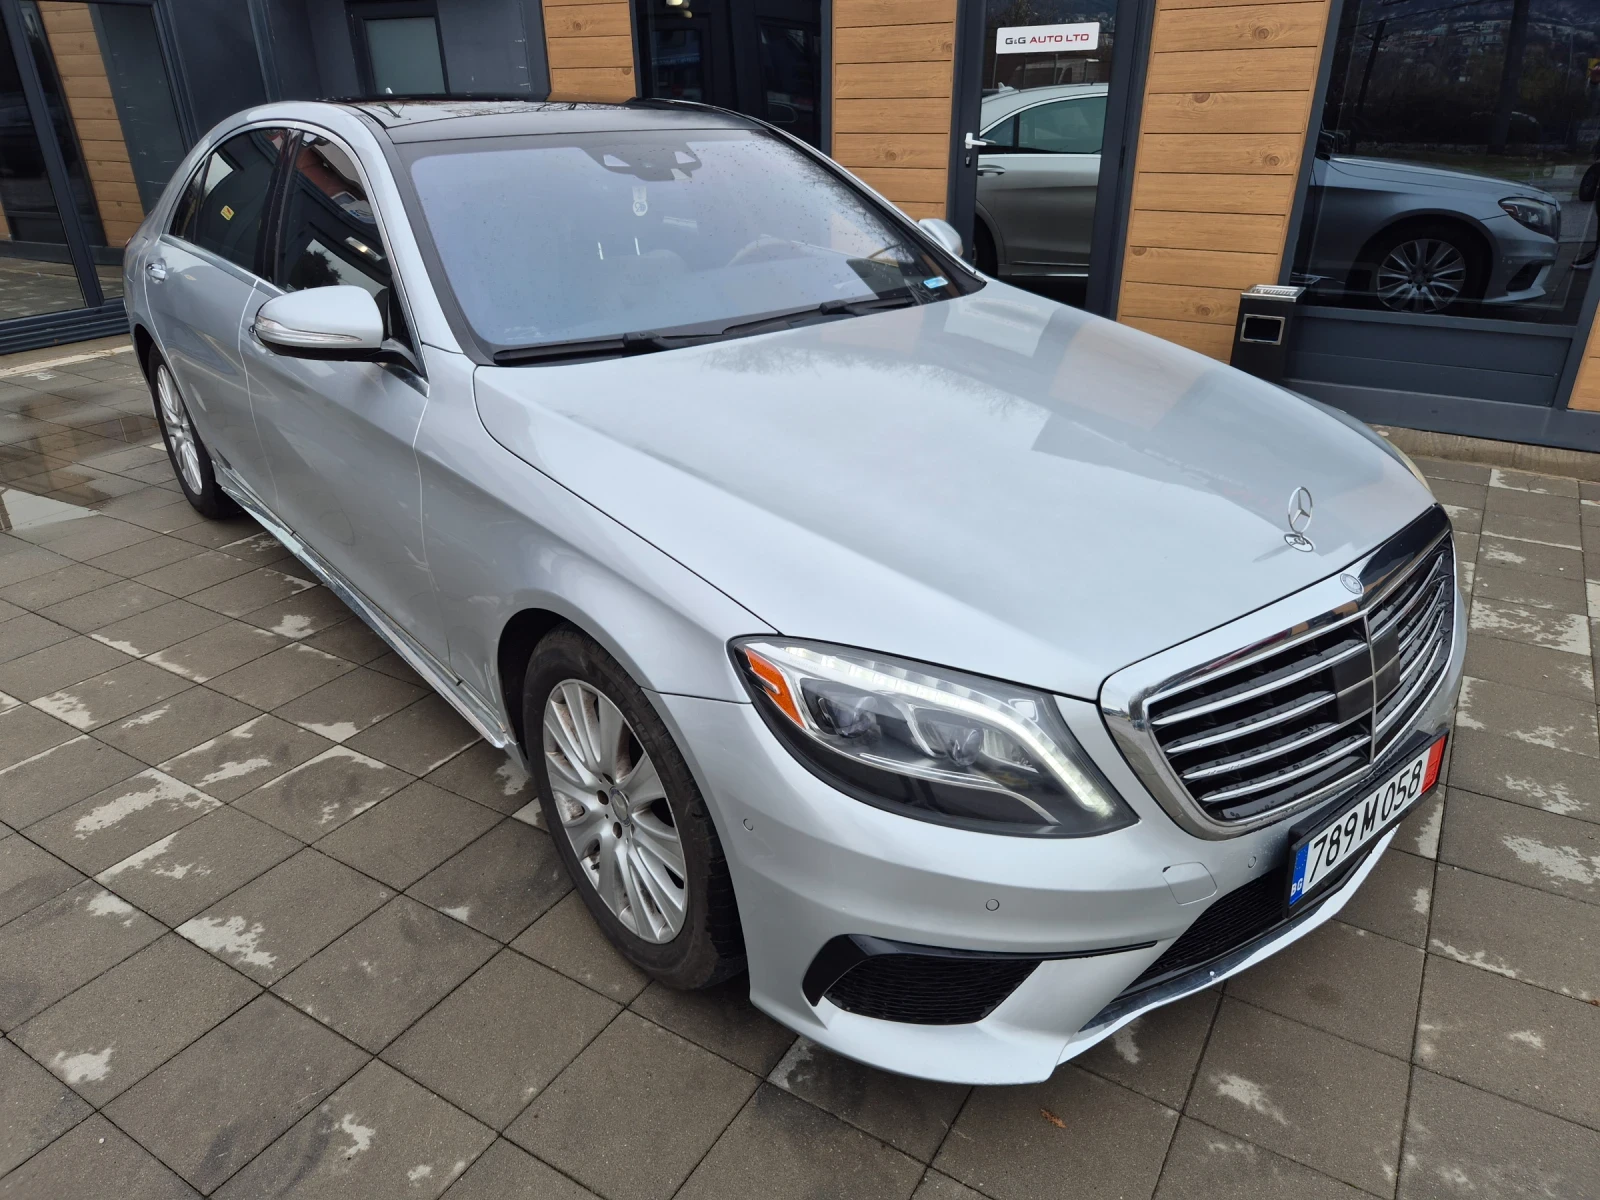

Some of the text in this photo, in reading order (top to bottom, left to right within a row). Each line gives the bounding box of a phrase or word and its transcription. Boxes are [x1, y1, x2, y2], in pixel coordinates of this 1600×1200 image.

[1005, 33, 1090, 44] G&G AUTO LTD
[1290, 877, 1304, 897] BG
